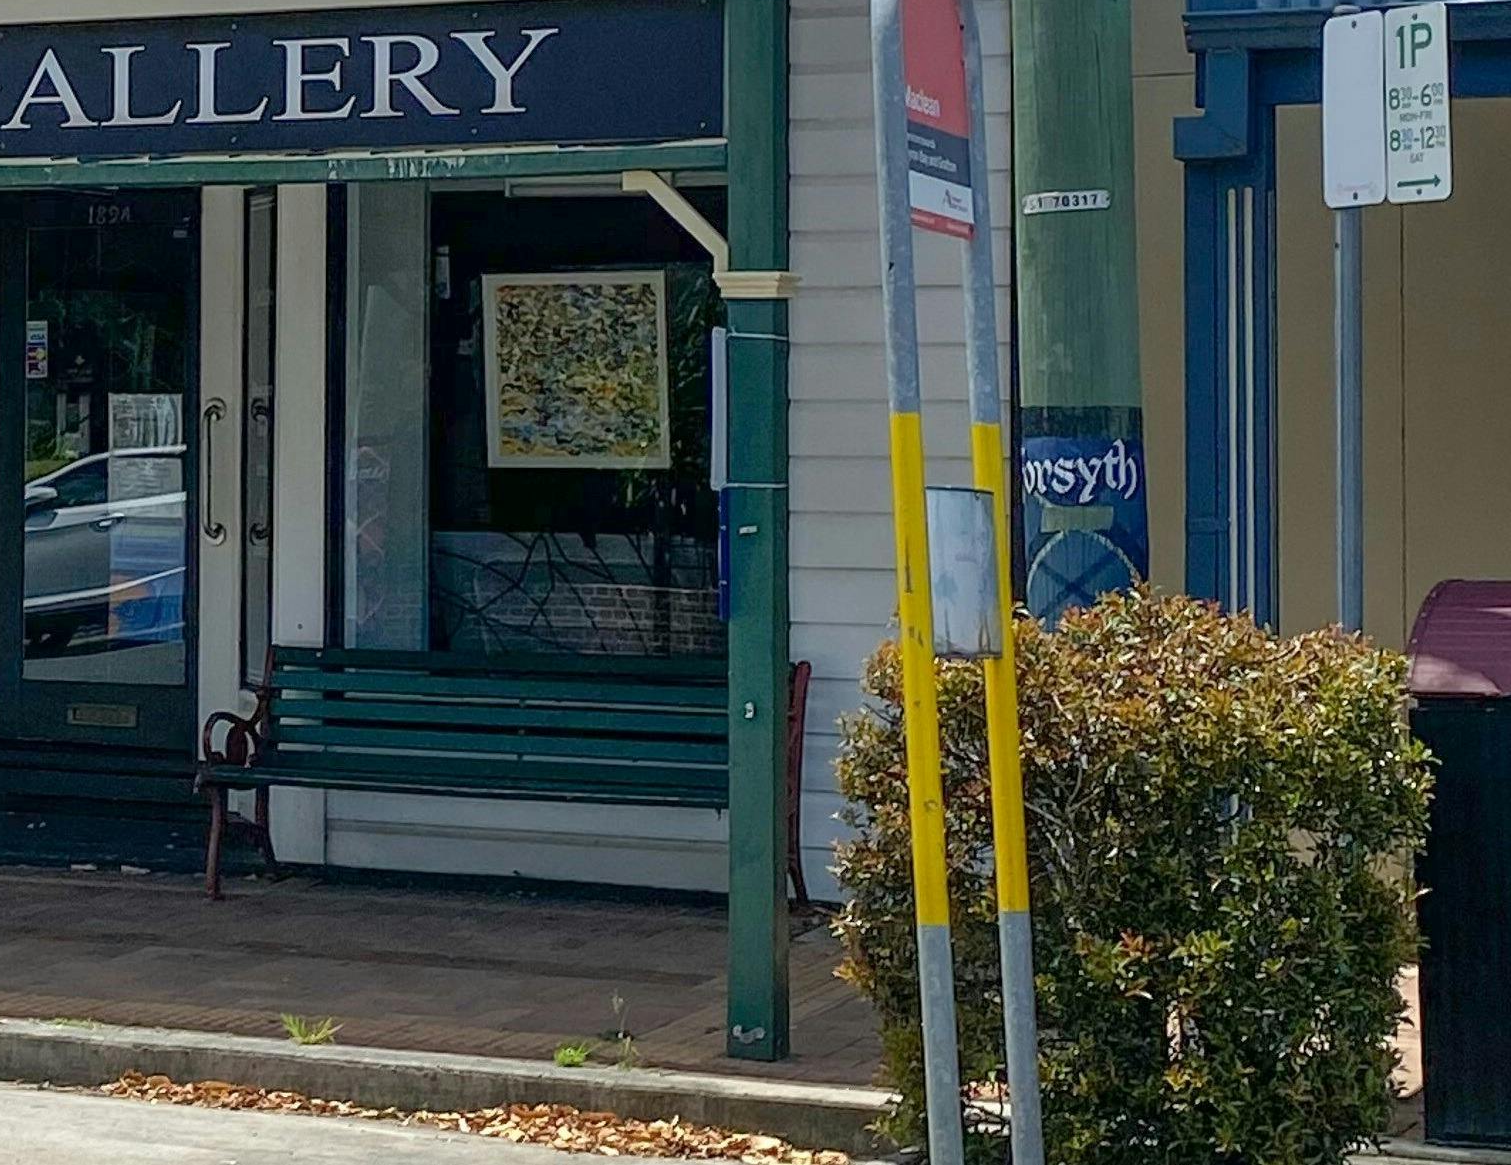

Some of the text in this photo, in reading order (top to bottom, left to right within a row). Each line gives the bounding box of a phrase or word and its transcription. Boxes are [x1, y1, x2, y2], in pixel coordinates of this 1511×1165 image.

[1395, 22, 1432, 69] 1P
[1054, 193, 1098, 209] 70317
[1022, 438, 1138, 503] orsyth
